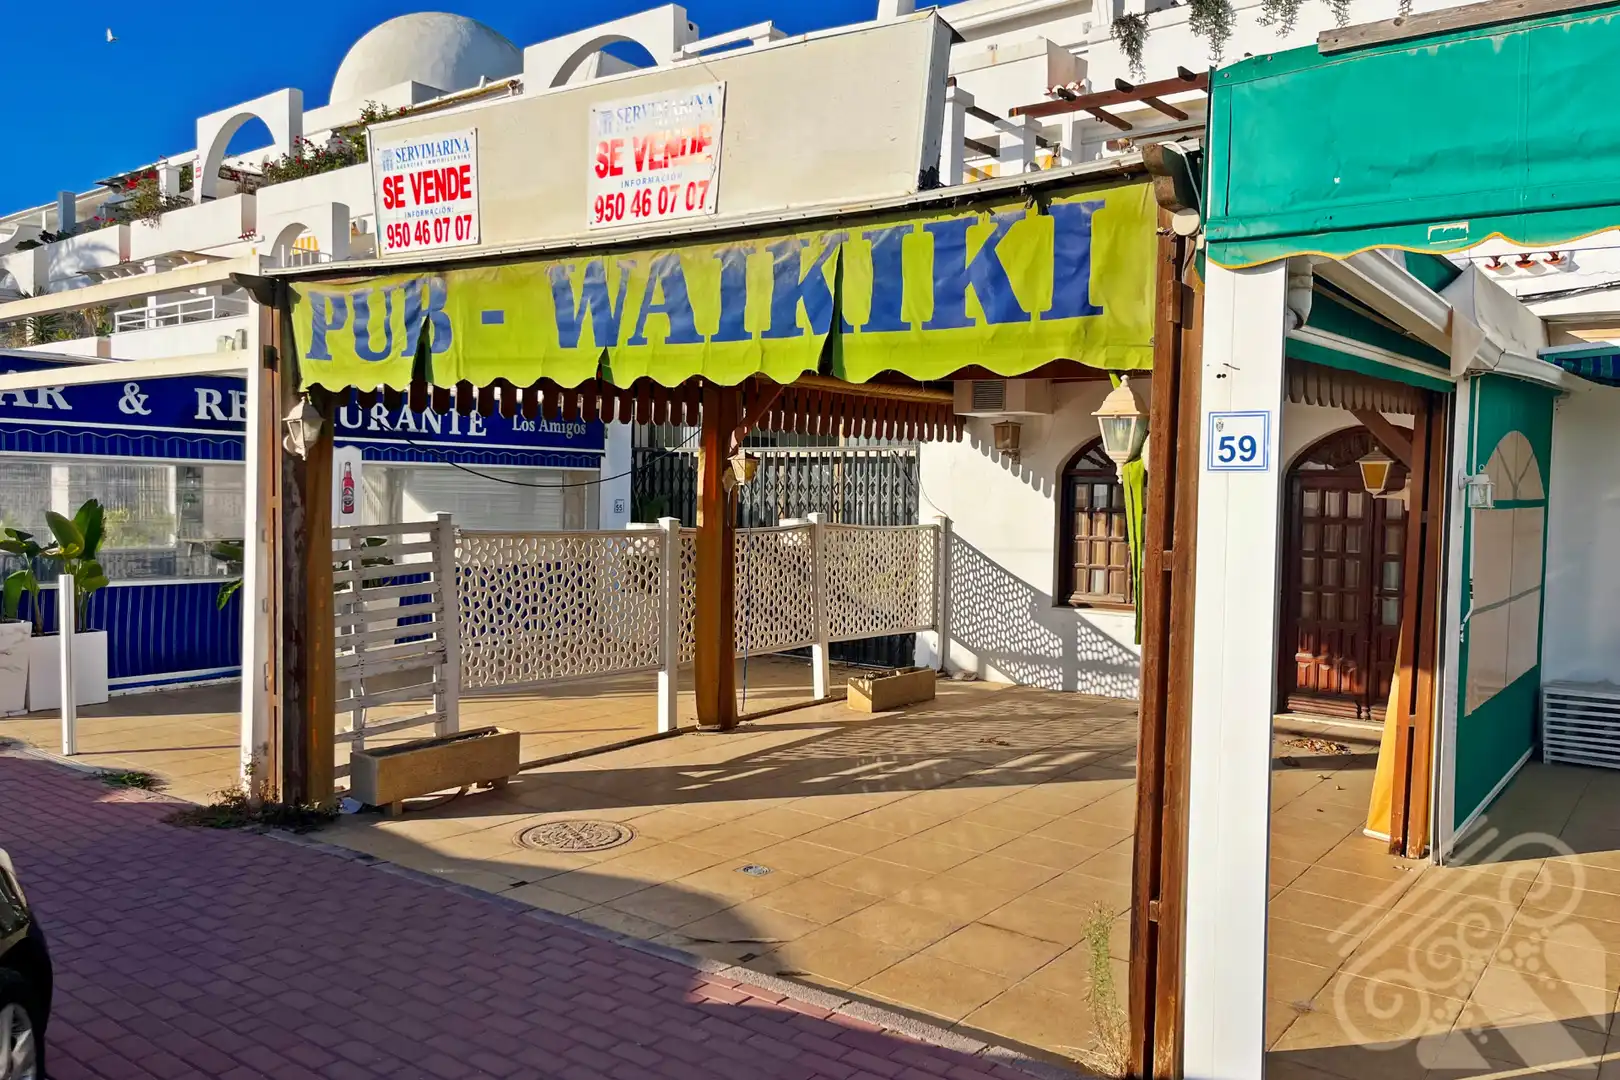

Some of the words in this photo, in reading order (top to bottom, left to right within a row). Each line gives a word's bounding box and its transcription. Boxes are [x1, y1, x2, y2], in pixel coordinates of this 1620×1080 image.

[396, 138, 469, 163] SERVIMARINA
[594, 137, 625, 179] SE
[382, 174, 406, 210] SE
[409, 164, 472, 206] VENDE
[594, 192, 626, 224] 950
[630, 187, 653, 218] 46
[657, 183, 681, 215] 07
[685, 179, 710, 211] 07
[386, 221, 411, 249] 950
[414, 219, 431, 246] 46
[433, 216, 451, 244] 07
[455, 213, 473, 241] 07
[305, 275, 453, 362] PUB
[543, 199, 1106, 349] WAIKIKI
[118, 382, 152, 416] &
[511, 414, 536, 432] Los
[538, 419, 587, 440] Amigos
[1217, 434, 1257, 463] 59
